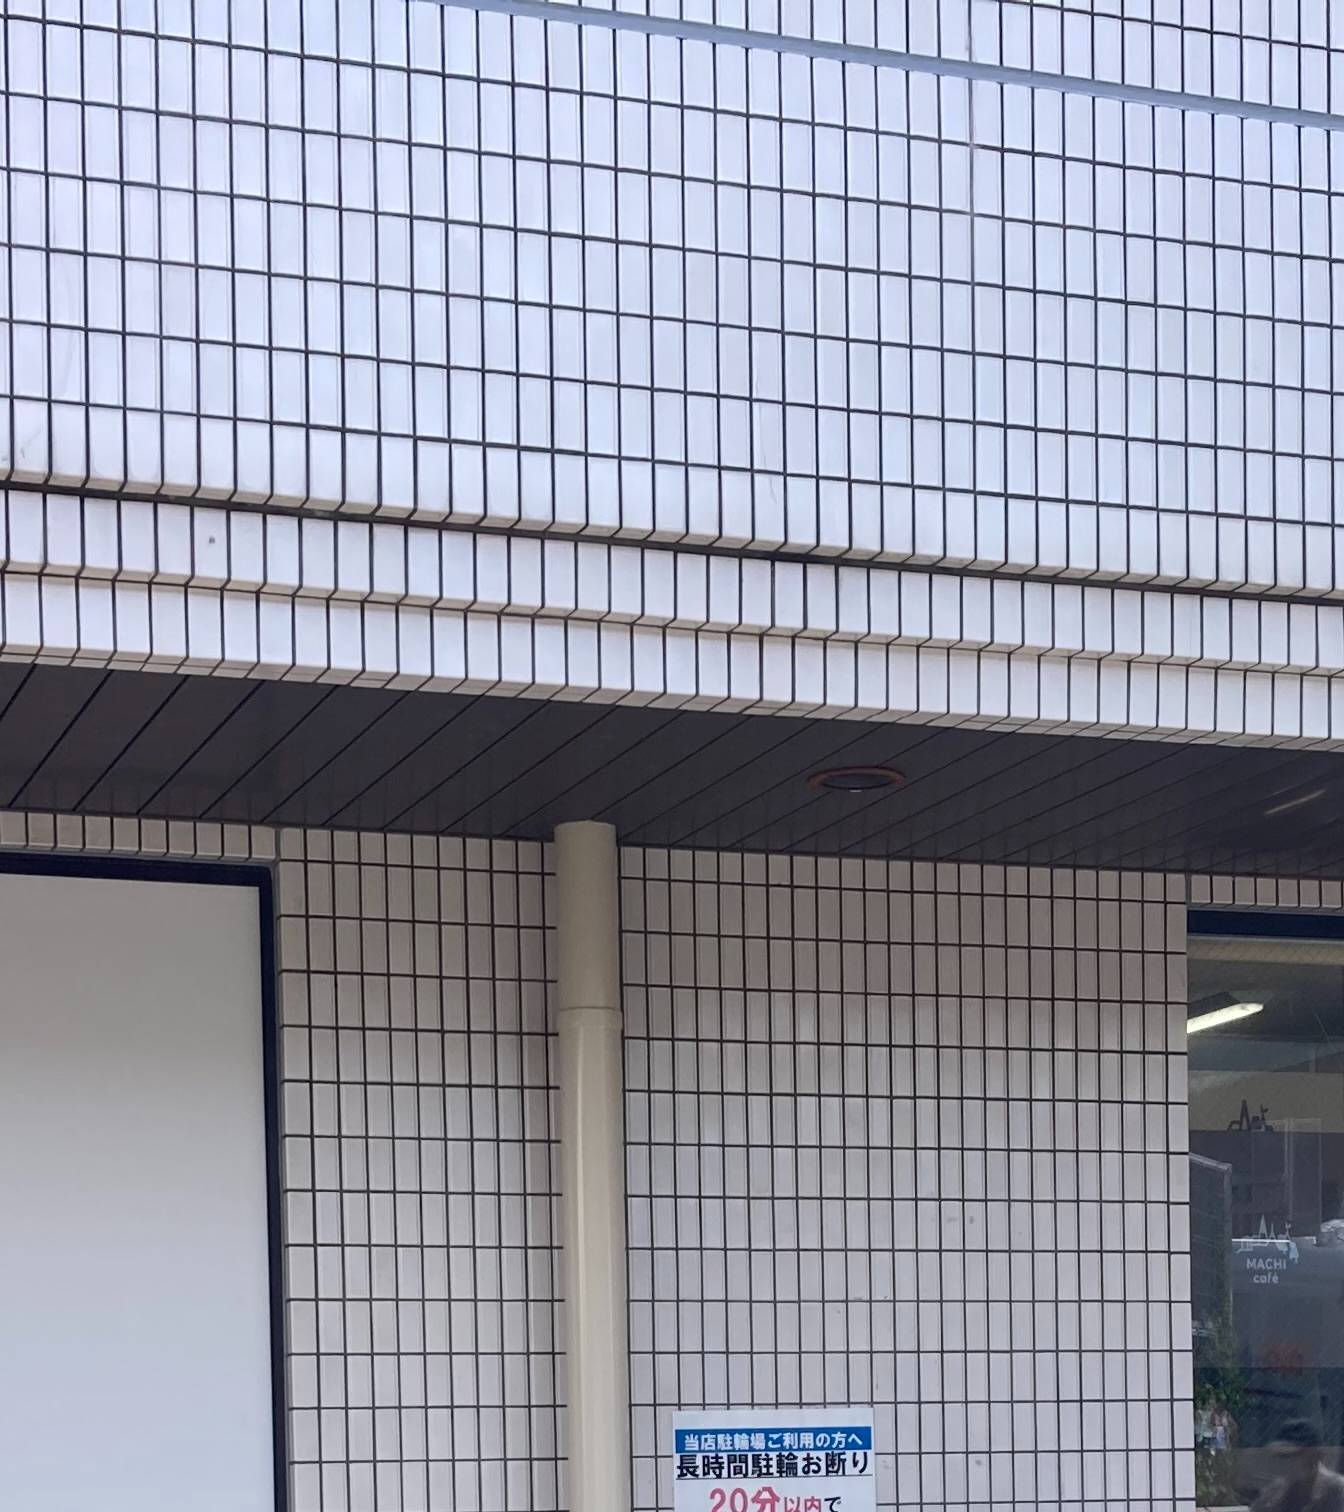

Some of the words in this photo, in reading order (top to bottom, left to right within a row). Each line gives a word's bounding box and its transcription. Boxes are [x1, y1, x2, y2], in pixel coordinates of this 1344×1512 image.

[1246, 1258, 1287, 1270] MACHI
[684, 1432, 862, 1451] 当店駐輪場ご利用の方へ
[676, 1452, 868, 1479] 長時間駐輪お断り
